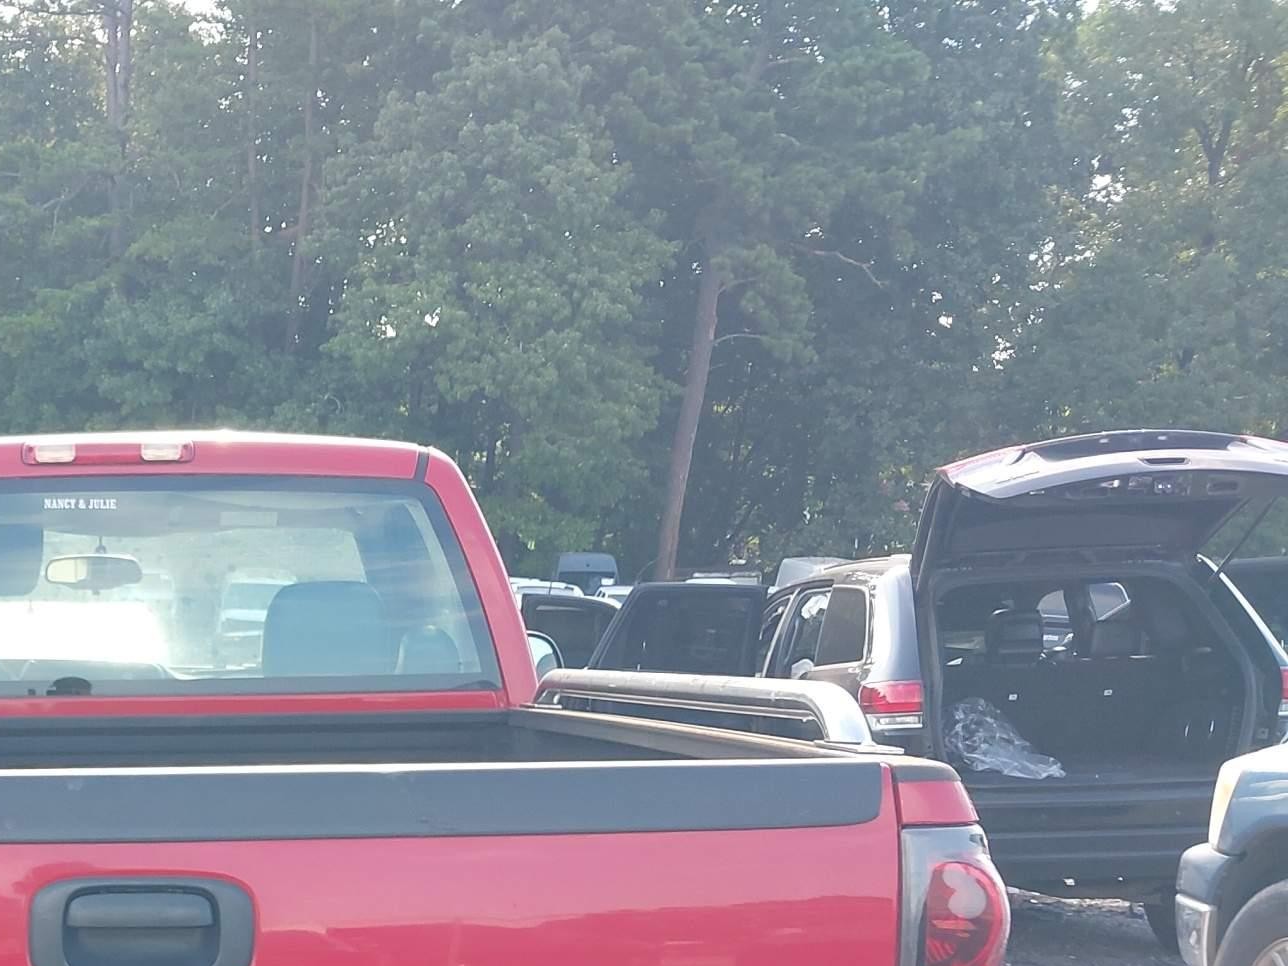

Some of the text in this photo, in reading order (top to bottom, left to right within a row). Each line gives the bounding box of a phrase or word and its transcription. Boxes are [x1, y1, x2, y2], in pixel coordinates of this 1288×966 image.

[43, 498, 117, 509] NANCY & JULIE
